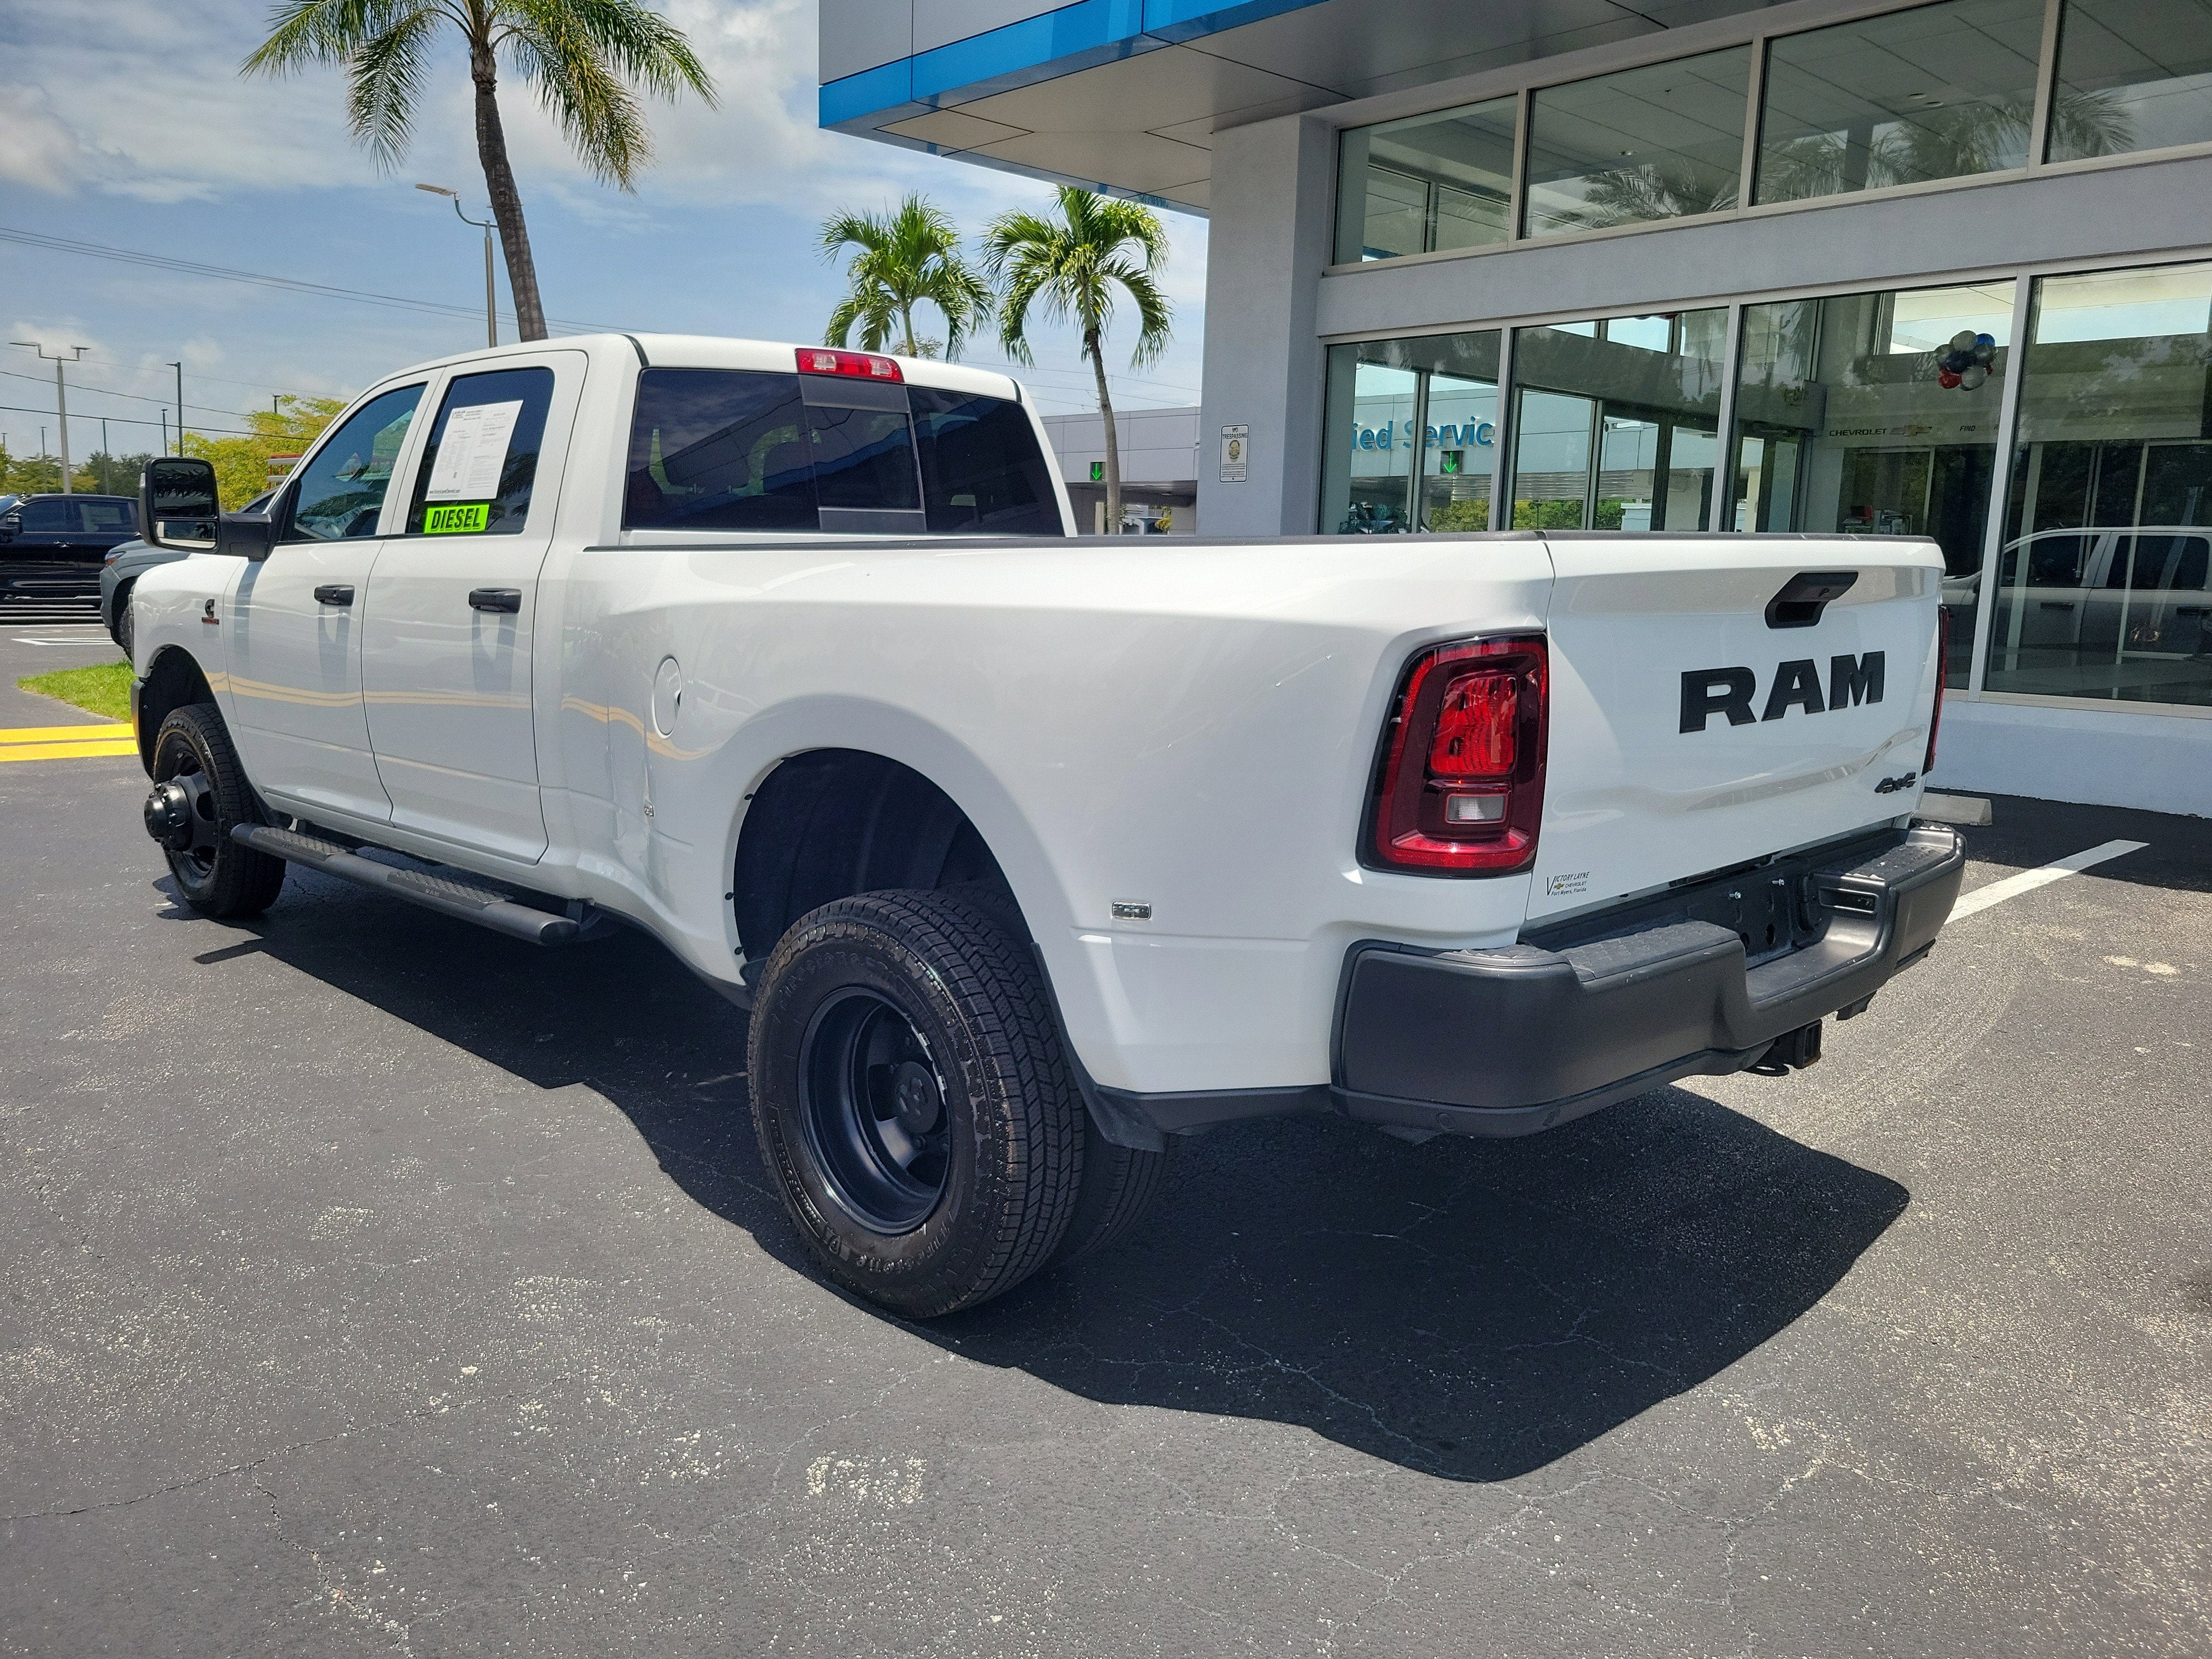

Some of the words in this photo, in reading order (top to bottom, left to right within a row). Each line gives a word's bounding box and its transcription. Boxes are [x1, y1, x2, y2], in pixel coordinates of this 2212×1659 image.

[431, 508, 481, 531] DIESEL
[1679, 651, 1885, 733] RAM
[1547, 873, 1574, 896] VICTORY
[1573, 871, 1590, 880] LAYNE
